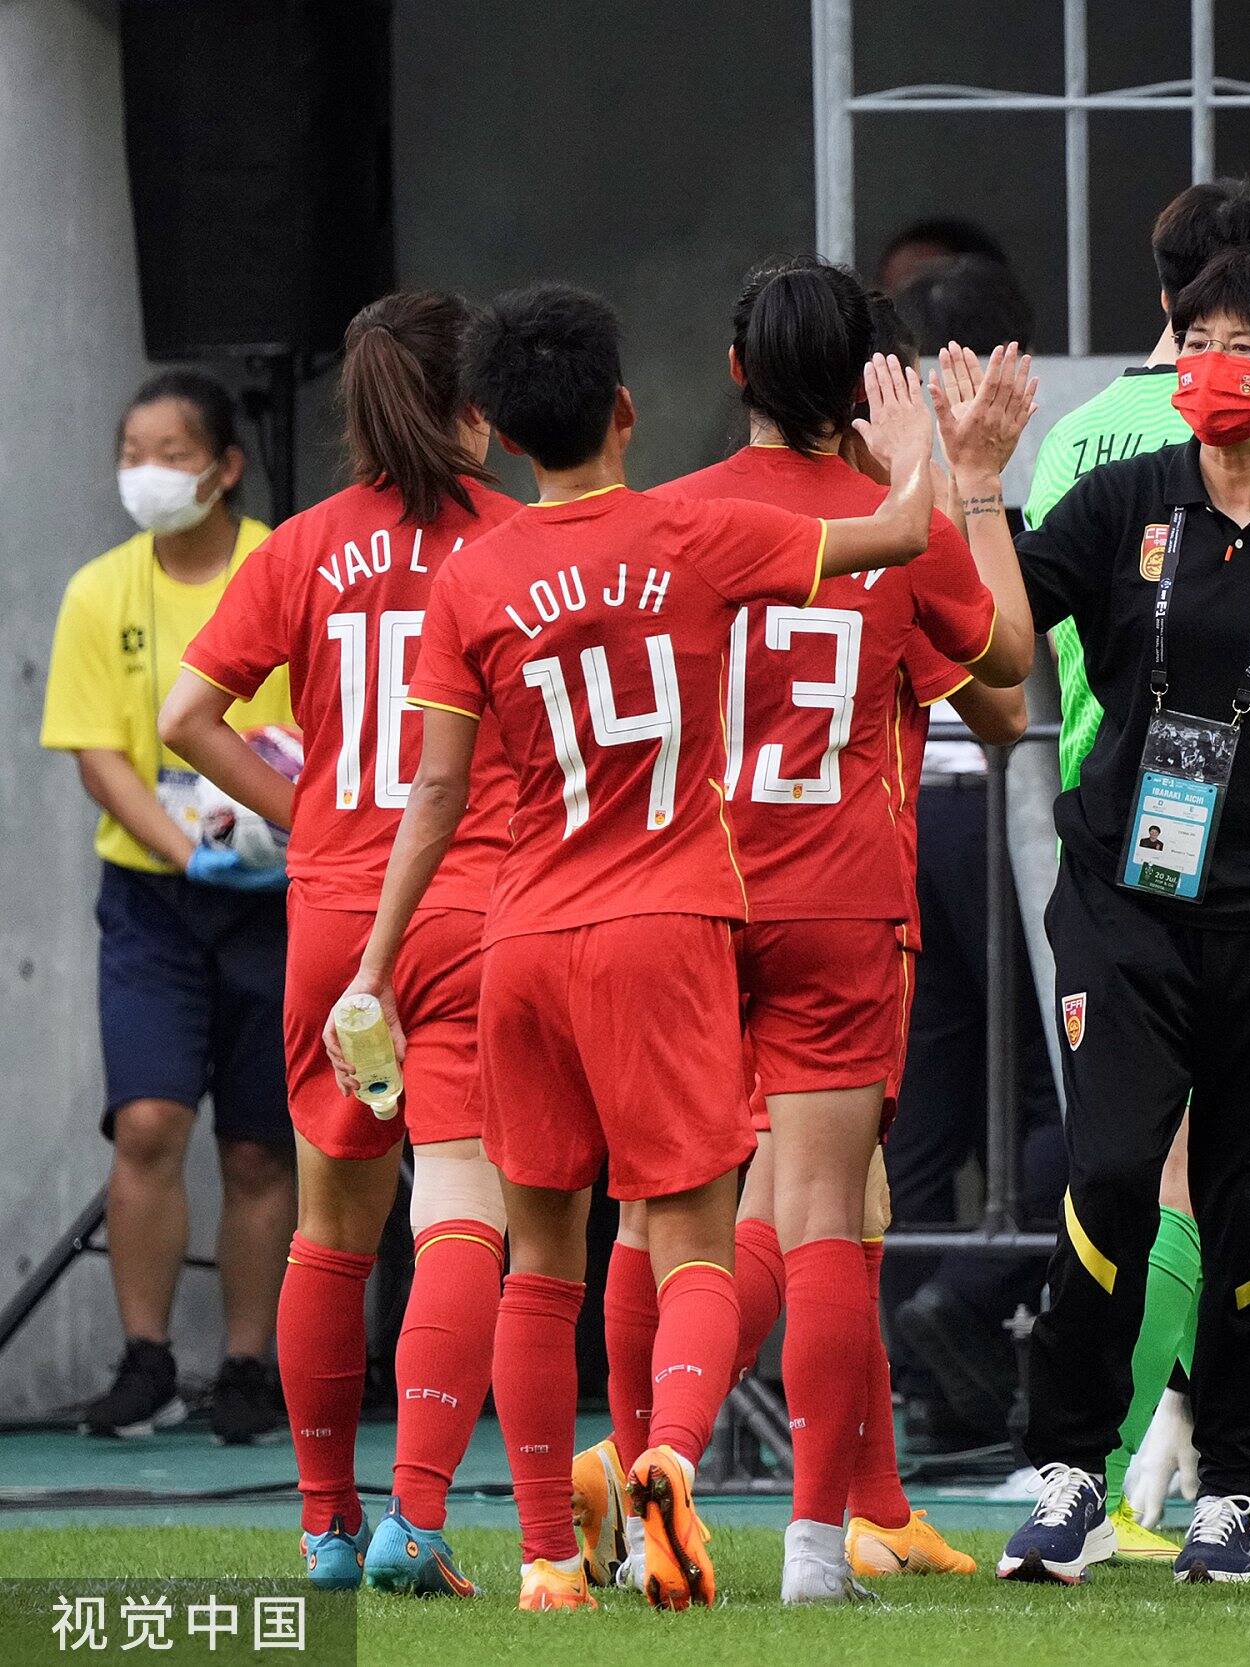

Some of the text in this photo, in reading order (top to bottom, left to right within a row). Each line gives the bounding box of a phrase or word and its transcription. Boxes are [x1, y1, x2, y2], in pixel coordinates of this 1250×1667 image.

[1146, 527, 1168, 539] CF
[316, 528, 428, 593] YAO L
[504, 565, 587, 640] LOU
[522, 633, 682, 841] 14
[1184, 793, 1204, 805] AICHI
[655, 1364, 703, 1383] CFA
[405, 1388, 458, 1409] CFA
